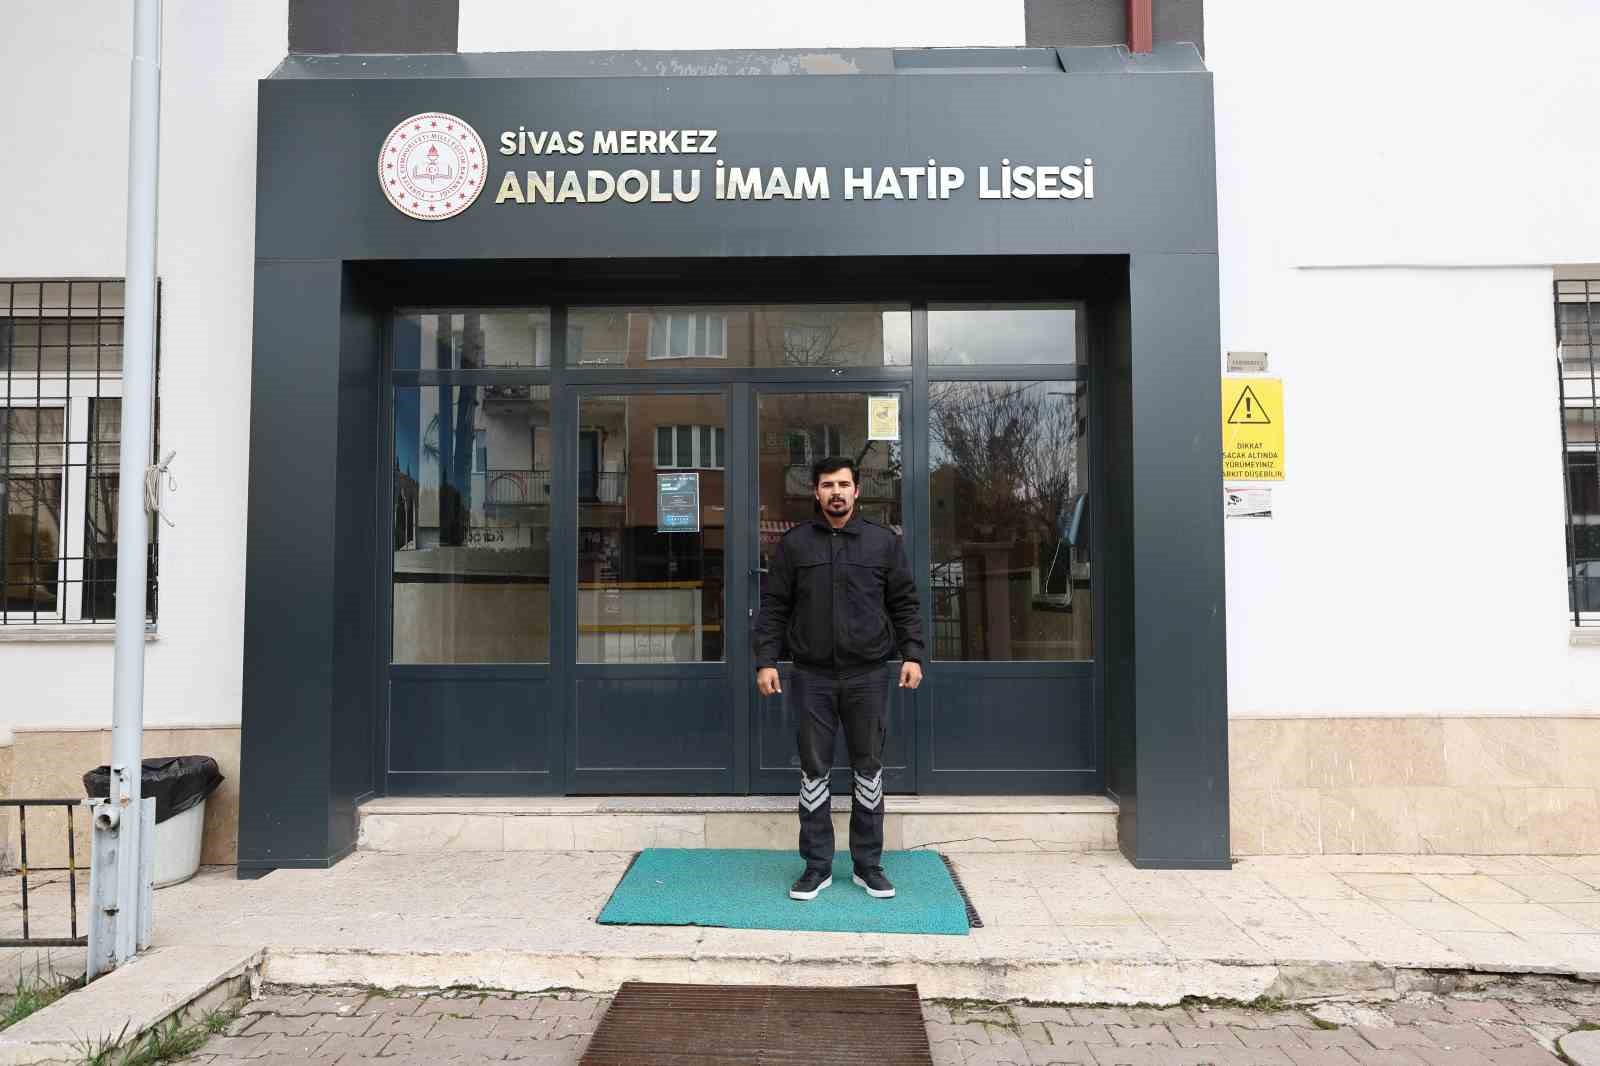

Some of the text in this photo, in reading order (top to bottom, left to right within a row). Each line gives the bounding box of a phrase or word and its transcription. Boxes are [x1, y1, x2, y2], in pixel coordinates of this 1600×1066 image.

[499, 126, 718, 156] SİVAS MERKEZ
[495, 157, 1095, 203] ANADOLU İMAM HATİP LİSESİ
[1248, 451, 1279, 459] ALTINDA
